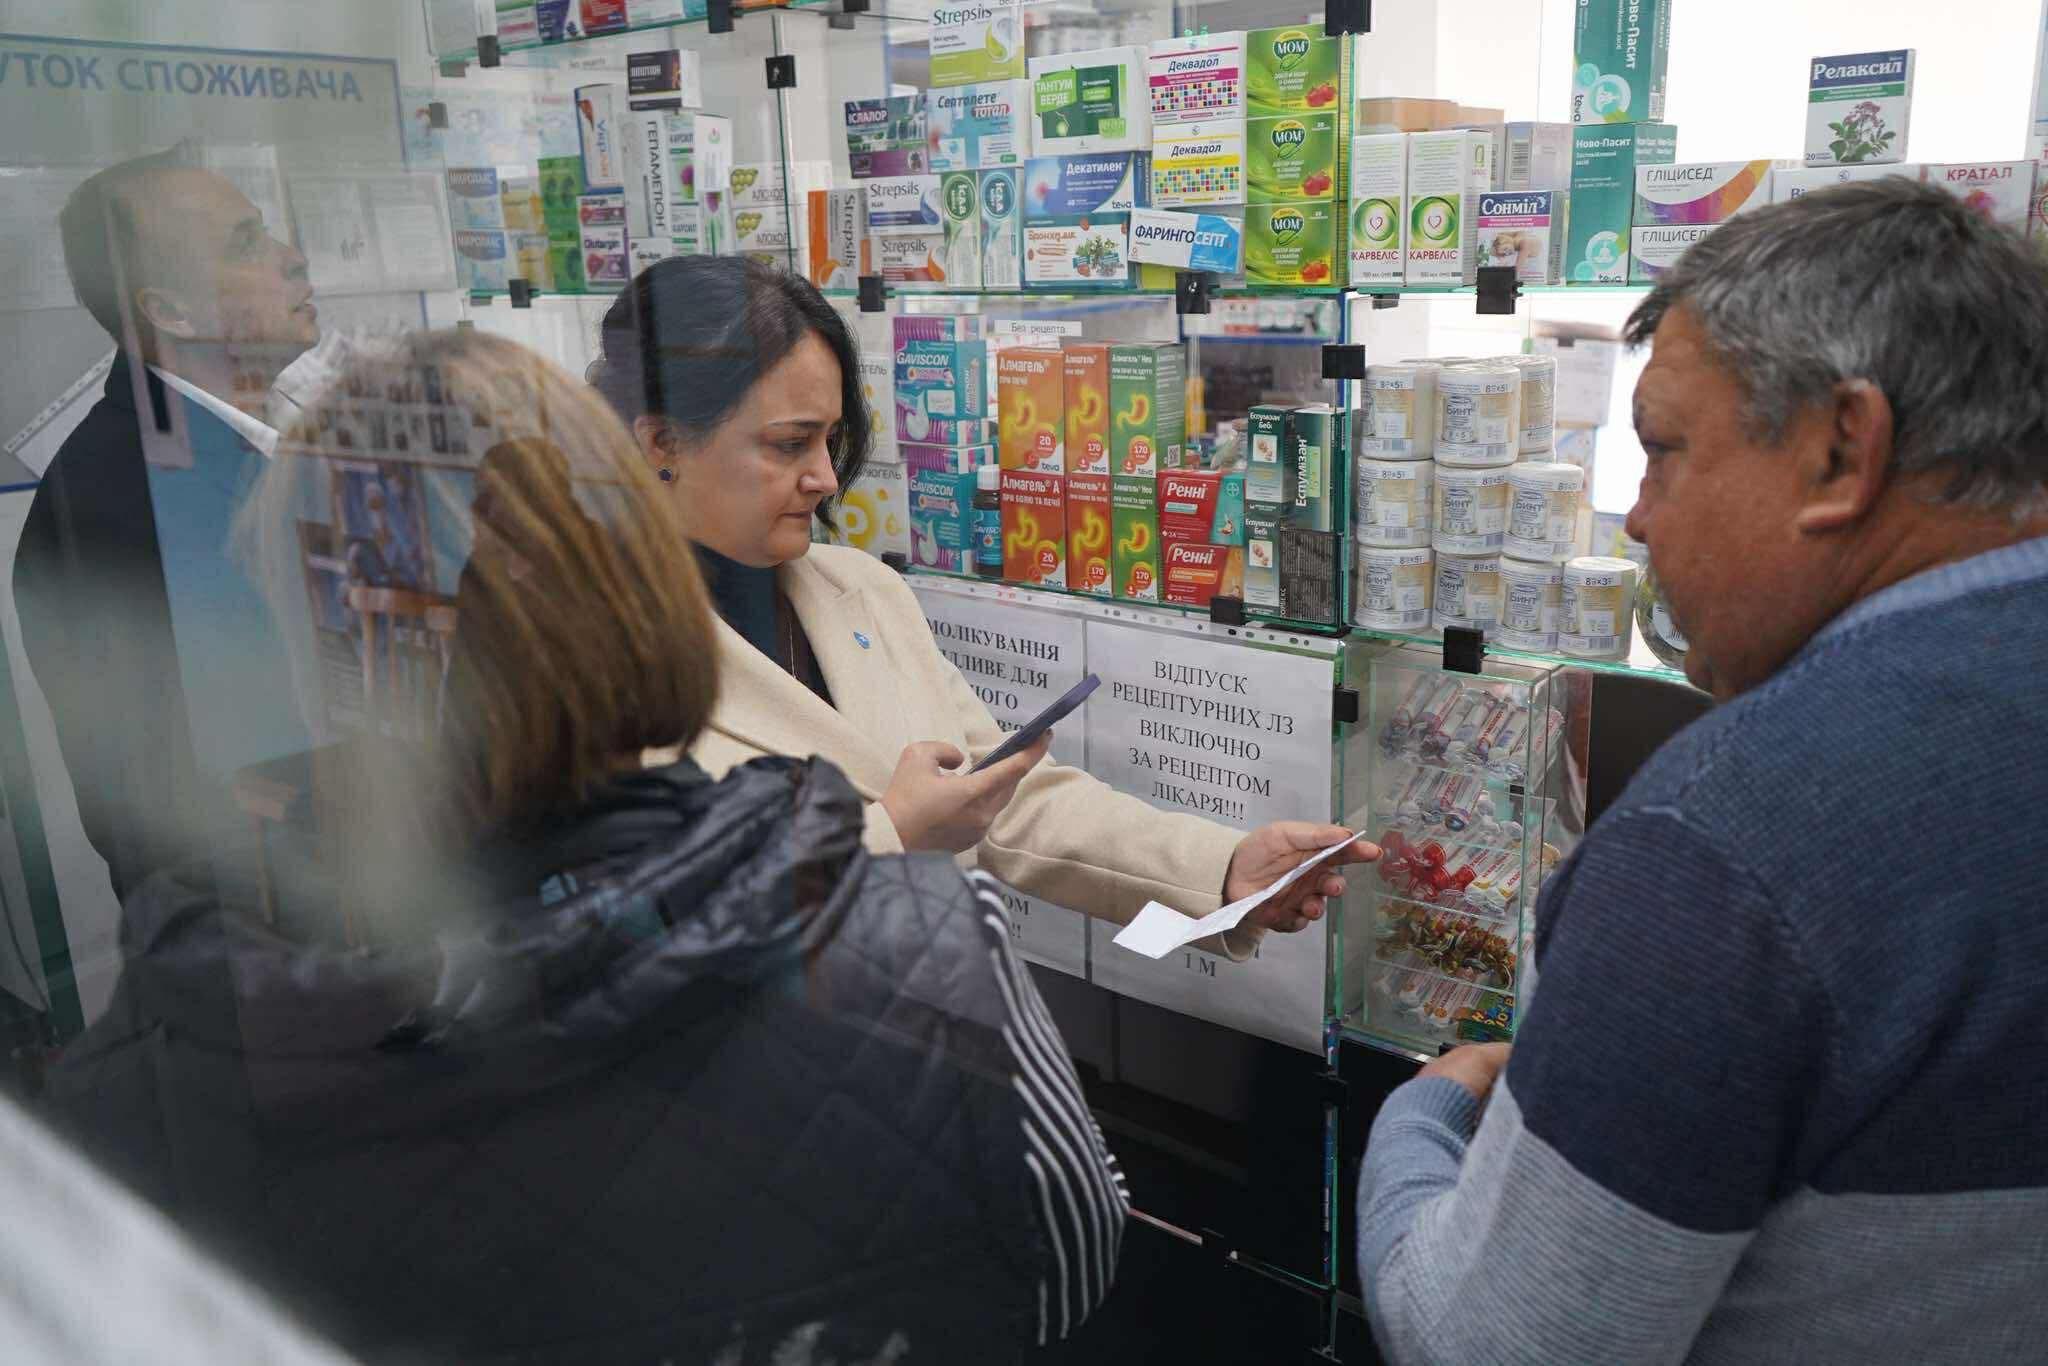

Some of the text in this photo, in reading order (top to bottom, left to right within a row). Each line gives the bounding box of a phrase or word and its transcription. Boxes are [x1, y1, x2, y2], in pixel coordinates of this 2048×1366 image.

[1625, 0, 1640, 69] ово-Пасит
[1168, 57, 1220, 72] Деквадол
[1812, 60, 1903, 80] Релаксил
[117, 57, 364, 101] СПОЖИВАЧА
[1036, 78, 1073, 93] ТАНТУМ
[937, 92, 997, 109] Септолете
[1040, 94, 1070, 106] ВЕРДЕ
[1574, 94, 1585, 122] teva
[1576, 137, 1632, 149] Ново-Пасит
[1171, 144, 1222, 158] Деквадол
[1806, 153, 1815, 161] 20
[1066, 161, 1123, 177] Декатилен
[1646, 167, 1713, 182] ГЛІЦИСЕД
[1946, 166, 2013, 181] КРАТАЛ
[870, 182, 920, 199] Strepsils
[1481, 198, 1538, 216] Сонміл
[843, 194, 858, 267] Strepsils
[1135, 224, 1229, 248] ФАРИНГОСЕПТ
[882, 239, 927, 255] Strepsils
[1352, 251, 1399, 261] КАРВЕЛІС
[1409, 250, 1458, 260] КАРВЕЛІС
[1011, 323, 1027, 333] Без
[896, 352, 949, 366] GAVISCON
[1000, 357, 1044, 374] Алмагель
[1065, 354, 1095, 365] Алмагель
[1039, 436, 1051, 445] 20
[1088, 443, 1101, 452] 170
[1134, 445, 1148, 454] 170
[1041, 463, 1060, 472] teva
[1091, 465, 1107, 473] teva
[1137, 468, 1153, 476] teva
[1295, 439, 1308, 508] Еспумізан
[910, 479, 954, 496] GAVISCON
[1002, 475, 1060, 493] Алмагель А
[1069, 480, 1107, 491] Алмагель А
[1113, 483, 1153, 494] Алмагель Нео
[1167, 482, 1207, 500] Ренні
[1042, 553, 1054, 562] 20
[1172, 546, 1214, 565] Ренні
[1091, 567, 1104, 576] 170
[1135, 570, 1149, 580] 170
[926, 617, 1060, 662] МОЛІКУВАННЯ
[942, 649, 1048, 689] ДЛИВЕ ДЛЯ
[1154, 661, 1247, 695] ВІДПУСК
[1112, 681, 1293, 735] РЕЦЕПТУРНИХ ЛЗ
[1139, 719, 1260, 761] ВИКЛЮЧНО
[1129, 747, 1270, 796] ЗА РЕЦЕПТОМ
[1151, 781, 1244, 820] ЛІКАРЯ!!!
